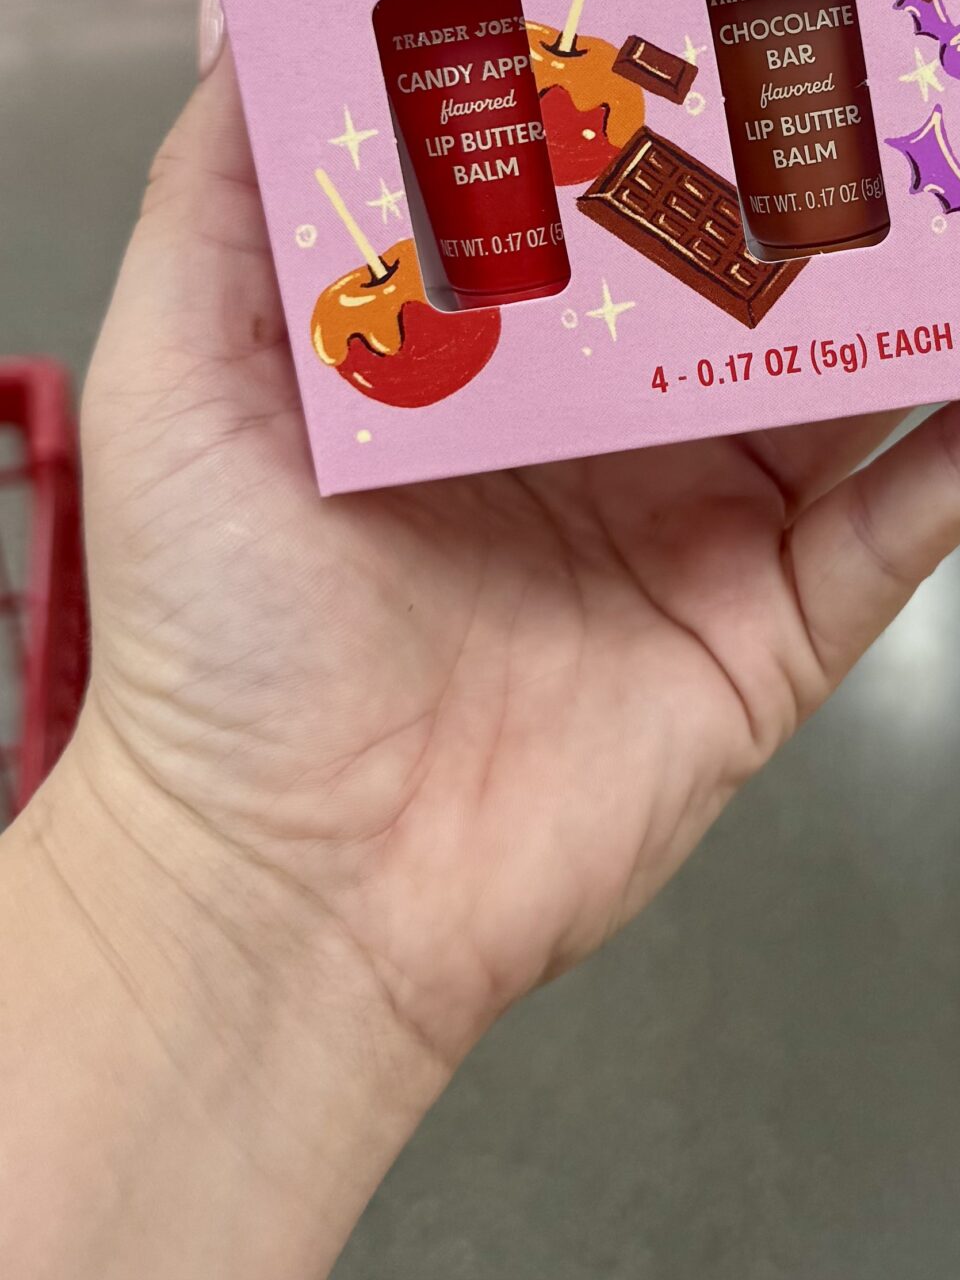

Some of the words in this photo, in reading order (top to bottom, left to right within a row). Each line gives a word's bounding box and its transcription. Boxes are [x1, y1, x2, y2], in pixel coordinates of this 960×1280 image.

[393, 25, 470, 51] TRADER
[719, 5, 854, 45] CHOCOLATE
[398, 63, 474, 94] CANDY
[482, 54, 534, 82] APP
[766, 44, 816, 70] BAR
[440, 89, 517, 125] flavored
[760, 73, 836, 109] flavored
[426, 136, 455, 158] LIP
[460, 121, 546, 153] BUTTER
[744, 119, 775, 141] LIP
[780, 104, 862, 138] BUTTER
[453, 157, 520, 185] BALM
[773, 140, 838, 169] BALM
[749, 195, 771, 214] NET
[773, 193, 802, 213] WT.
[805, 187, 835, 209] 0.17
[839, 182, 859, 203] OZ
[861, 173, 884, 201] (5g)
[440, 239, 459, 257] NET
[460, 238, 489, 257] WT.
[492, 231, 522, 255] 0.17
[526, 227, 548, 248] OZ
[550, 222, 564, 246] (5
[650, 365, 669, 395] 4
[697, 352, 755, 389] 0.17
[764, 345, 803, 376] OZ
[810, 333, 868, 376] (5g)
[875, 321, 954, 362] EACH
